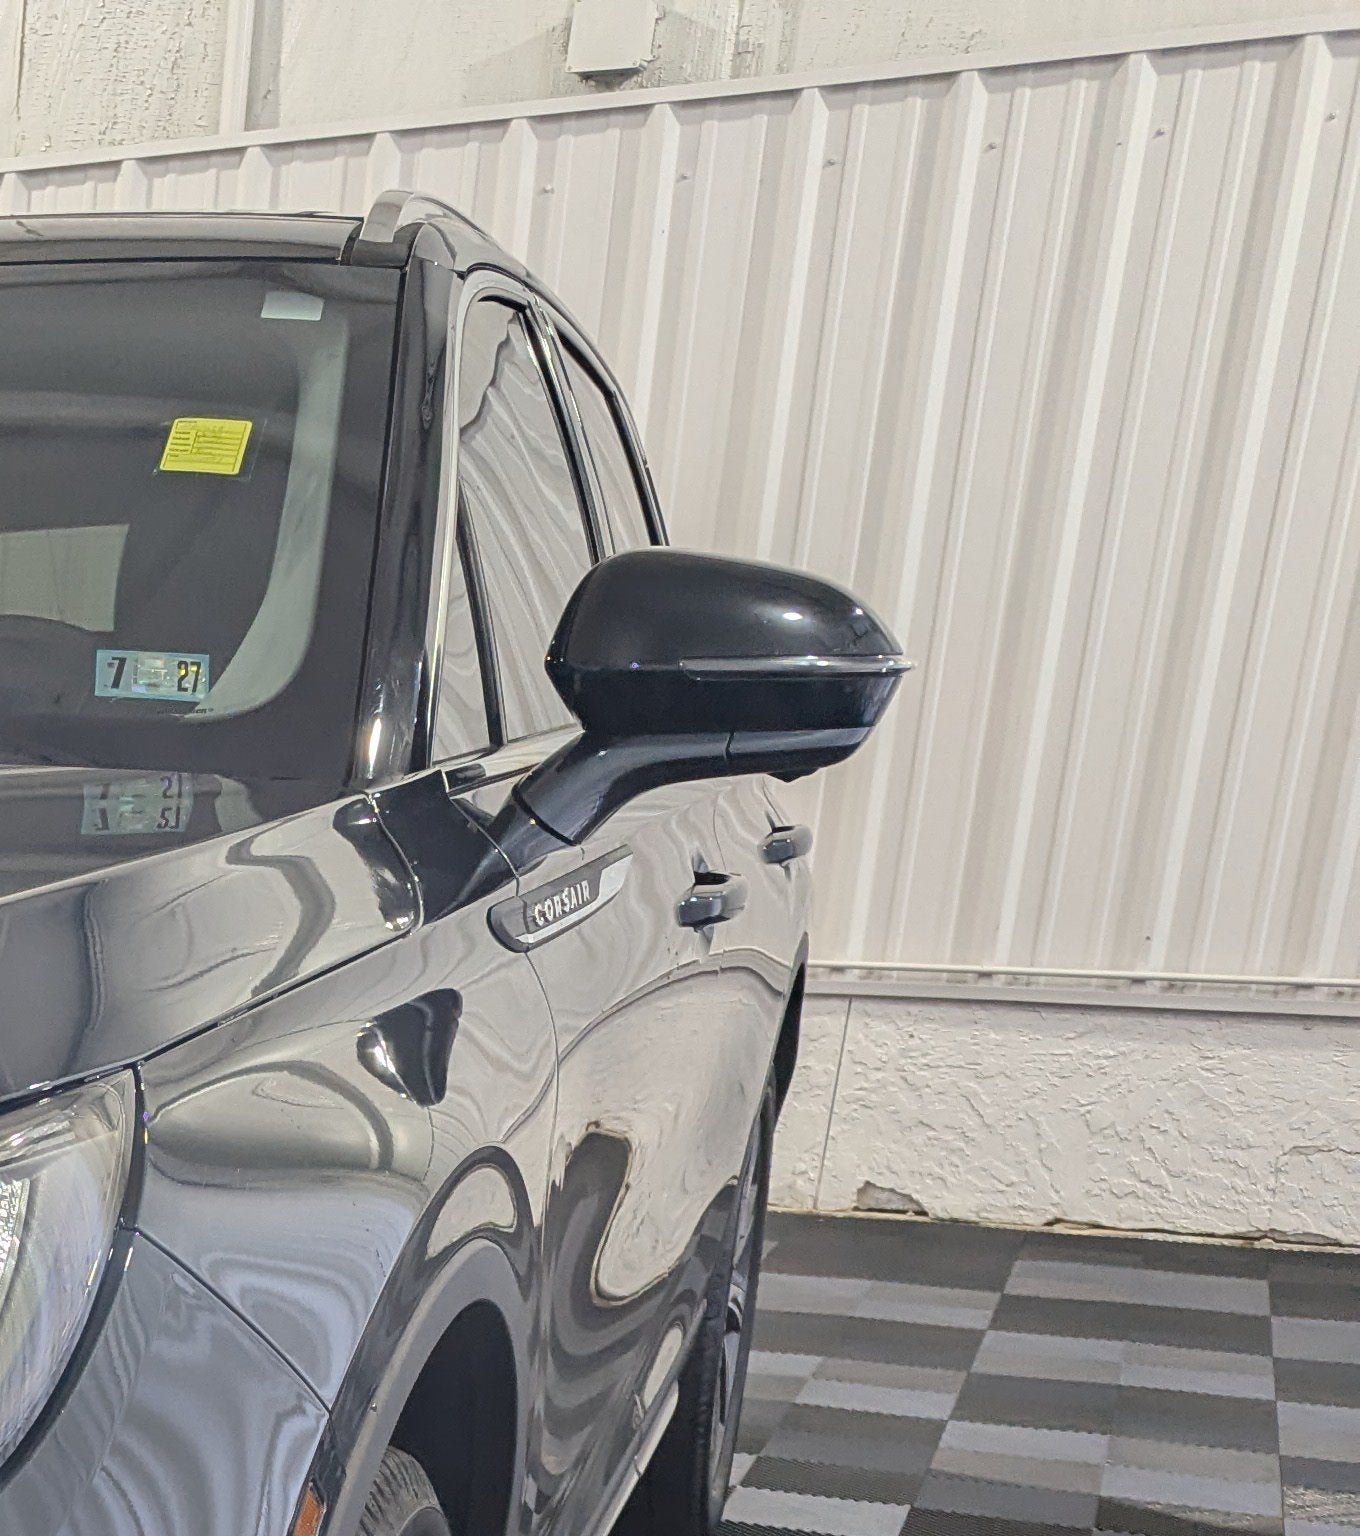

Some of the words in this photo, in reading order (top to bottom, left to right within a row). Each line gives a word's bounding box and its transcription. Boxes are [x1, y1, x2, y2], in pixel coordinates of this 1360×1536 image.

[110, 656, 128, 690] 7
[177, 660, 202, 694] 27
[533, 880, 591, 927] CORSAIR
